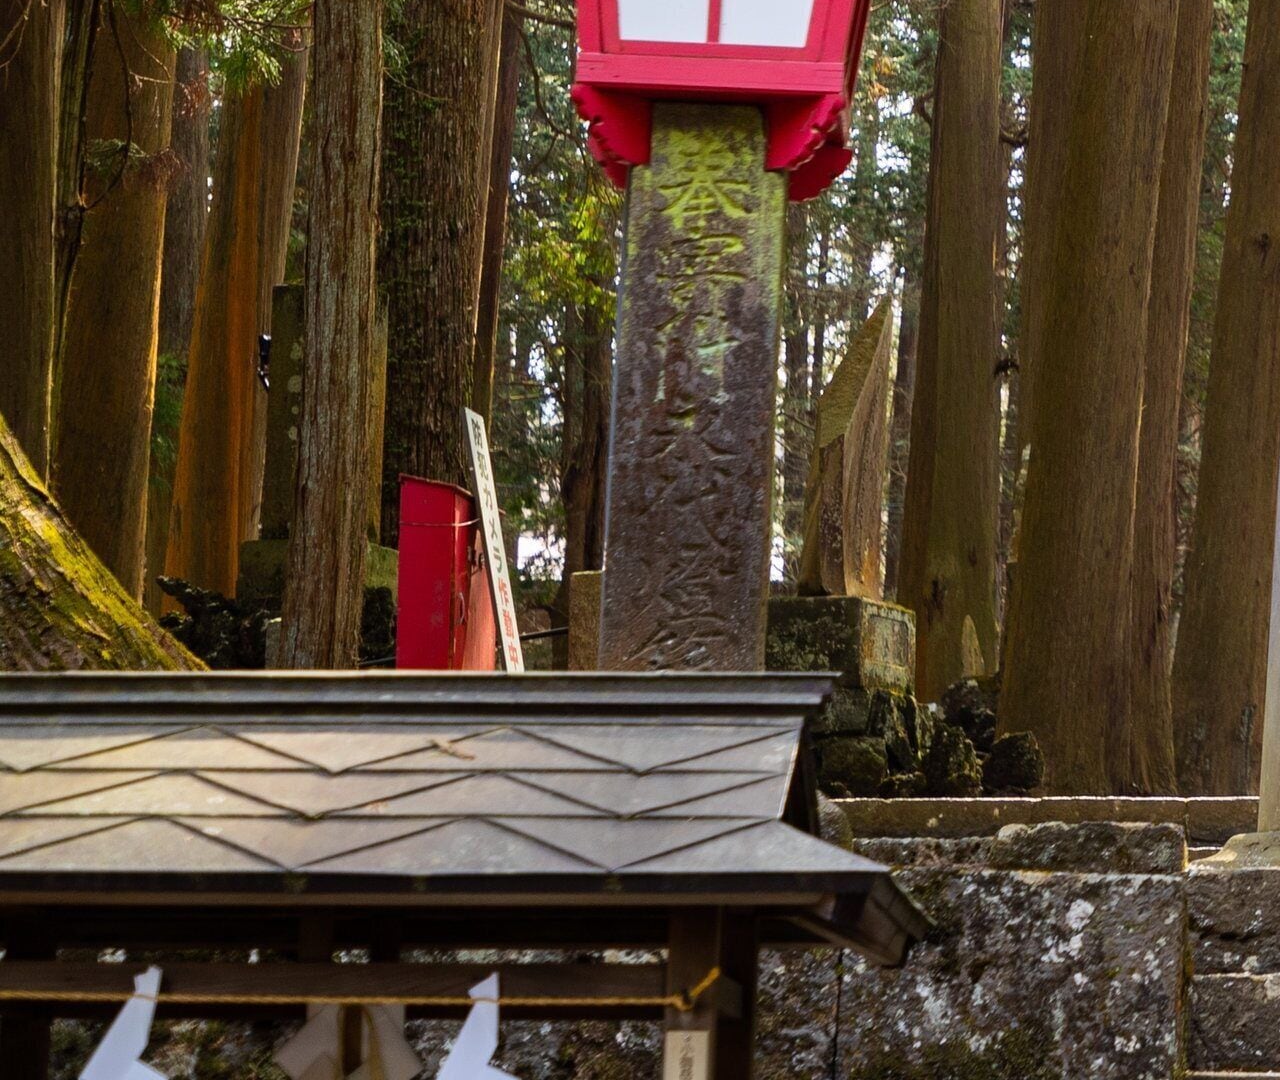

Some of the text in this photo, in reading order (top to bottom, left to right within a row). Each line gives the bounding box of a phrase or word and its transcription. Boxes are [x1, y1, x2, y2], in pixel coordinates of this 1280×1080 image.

[471, 418, 519, 669] 防犯カメラ作動中
